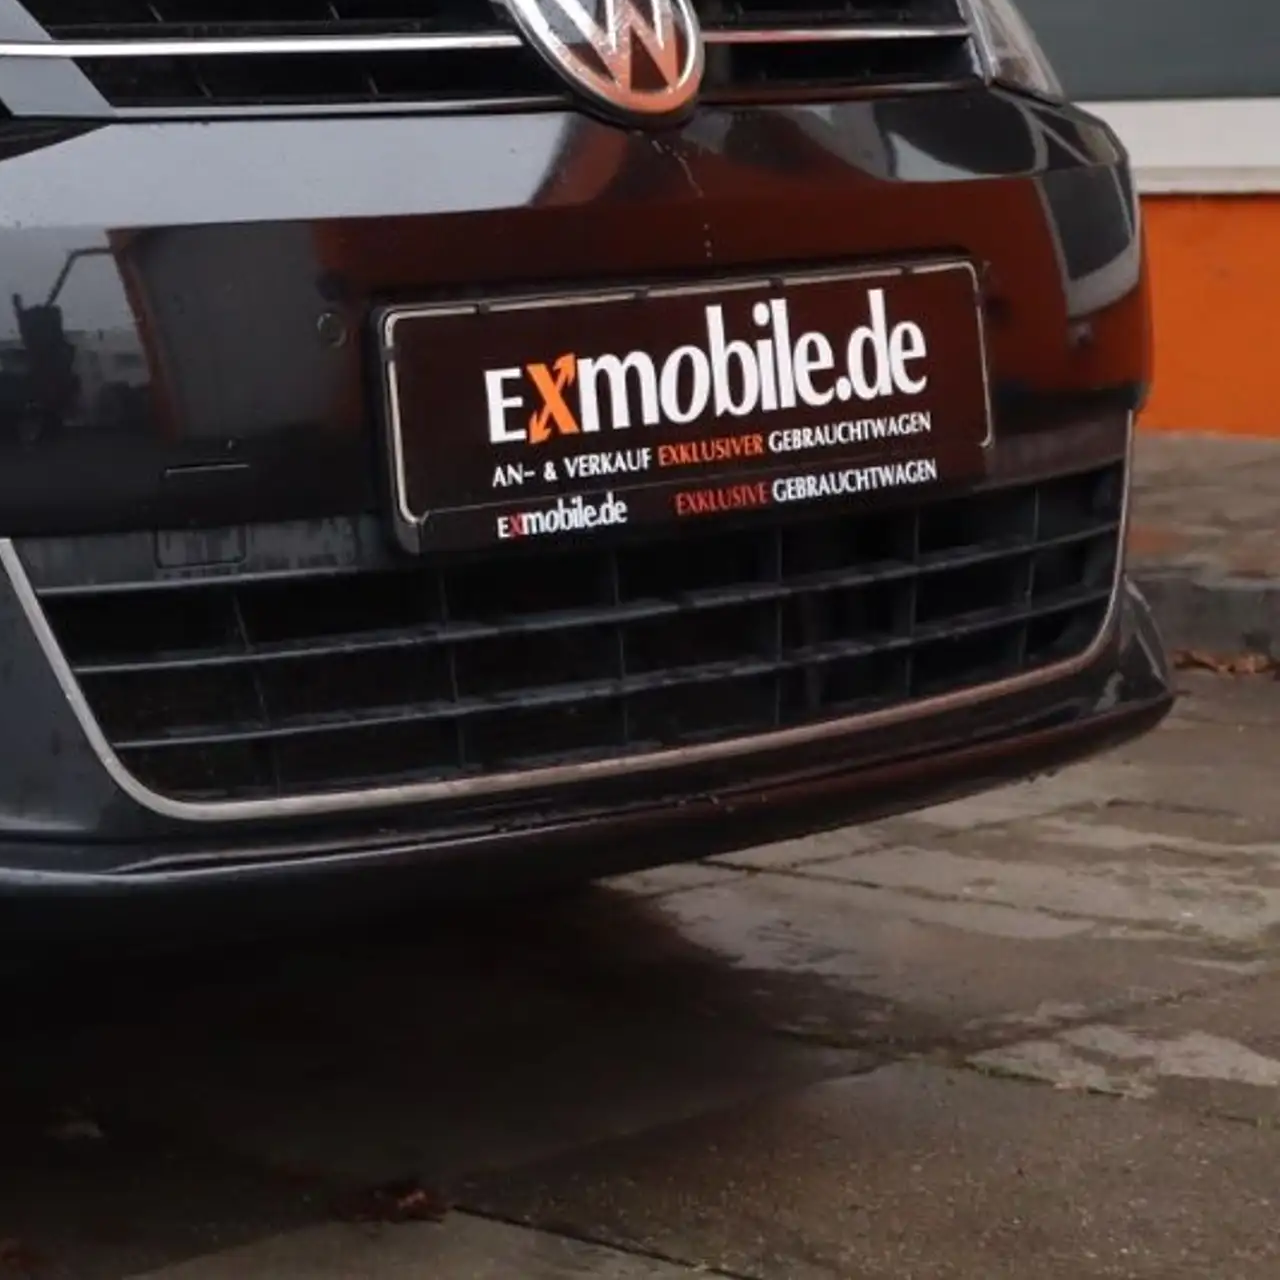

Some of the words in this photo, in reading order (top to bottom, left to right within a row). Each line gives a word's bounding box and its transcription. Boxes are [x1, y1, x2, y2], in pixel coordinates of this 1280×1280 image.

[483, 288, 928, 444] EXmobile.de
[491, 463, 537, 488] AN-
[543, 460, 559, 482] &
[563, 447, 653, 479] VERKAUF
[657, 433, 765, 467] EXKLUSIVER
[768, 411, 932, 453] GEBRAUCHTWAGEN
[496, 491, 628, 539] EXmobile.de
[675, 481, 770, 516] EXKLUSIVE
[772, 458, 938, 502] GEBRAUCHTWAGEN
